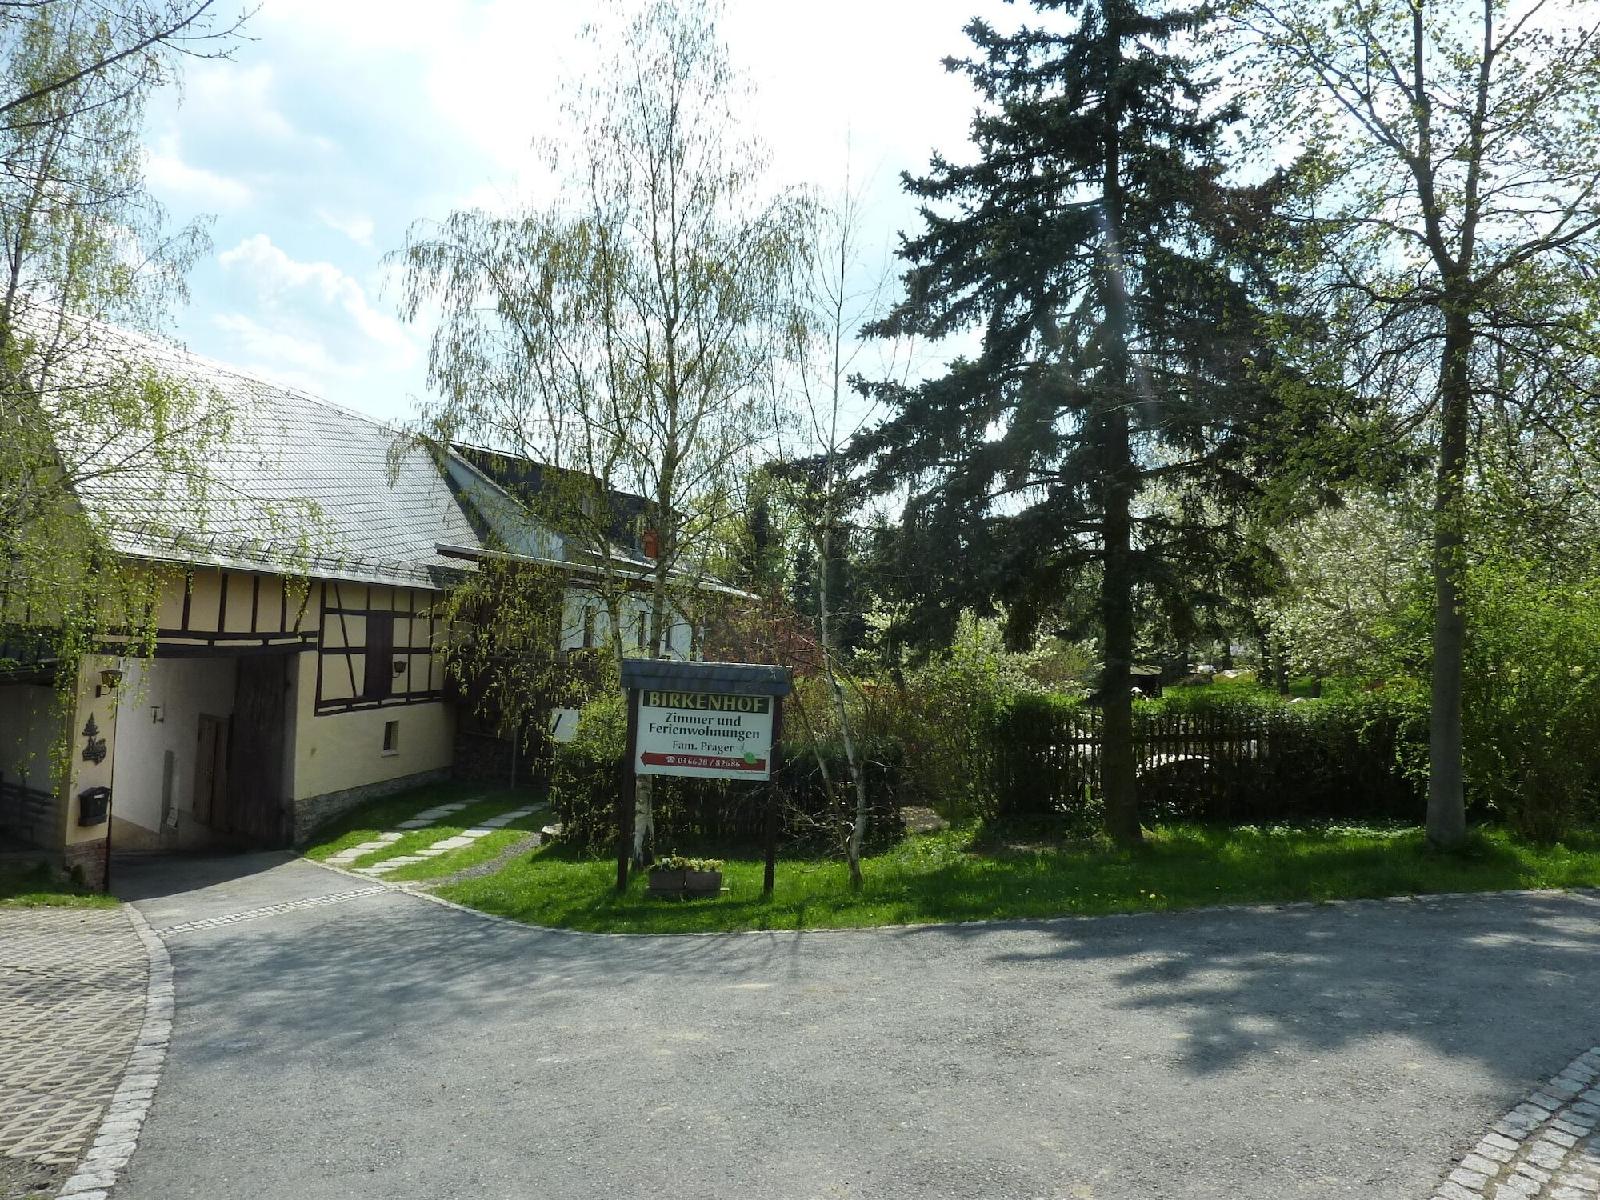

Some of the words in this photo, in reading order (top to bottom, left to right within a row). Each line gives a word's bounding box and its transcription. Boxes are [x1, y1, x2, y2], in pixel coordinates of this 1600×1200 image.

[649, 691, 764, 713] BIRKENHOF
[665, 712, 715, 726] Zimmer
[717, 715, 742, 727] und
[649, 722, 760, 741] Ferienwohnungen
[672, 740, 698, 751] Fam.
